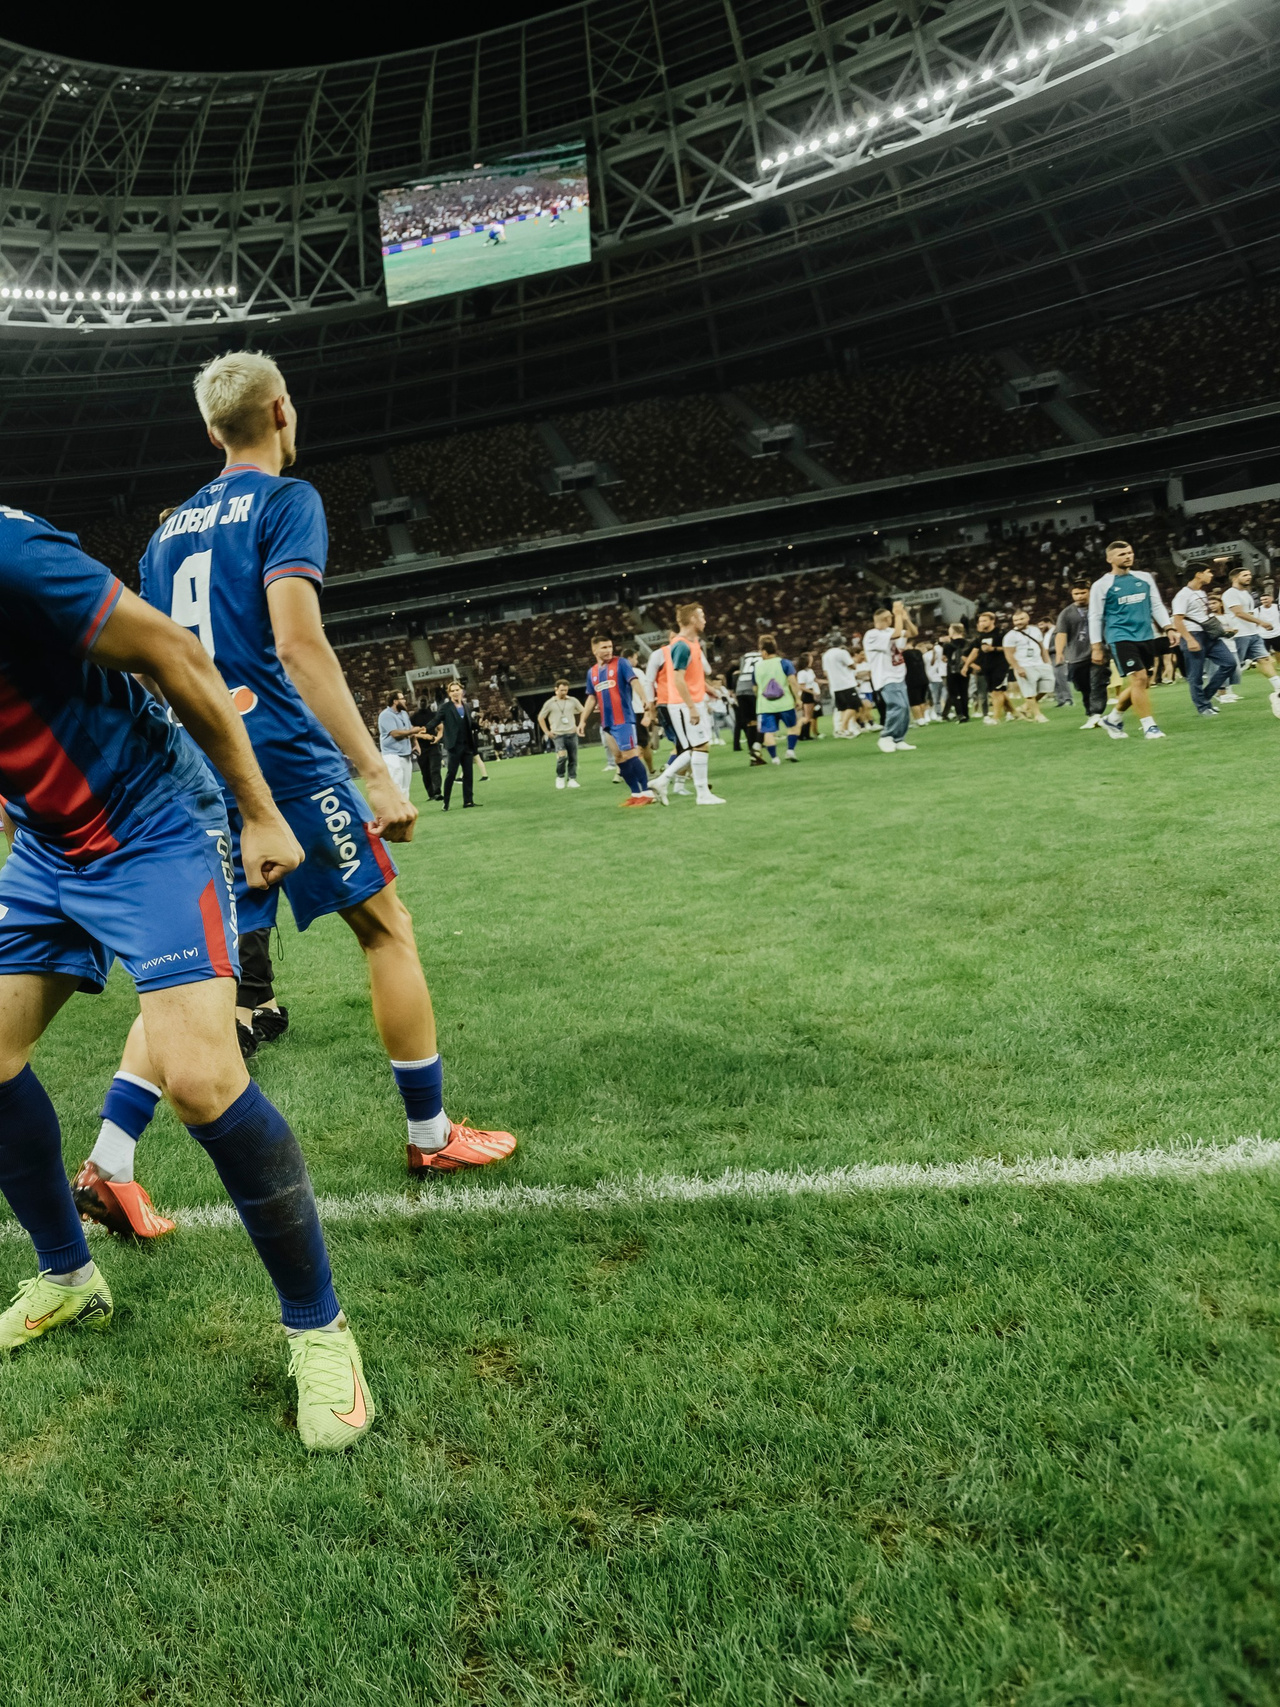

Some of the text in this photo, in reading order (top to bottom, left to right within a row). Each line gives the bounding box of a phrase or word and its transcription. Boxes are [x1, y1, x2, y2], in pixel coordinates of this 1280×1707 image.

[219, 493, 255, 525] JR
[1220, 544, 1238, 552] 117
[171, 549, 216, 663] 9
[141, 952, 182, 971] KAVARA
